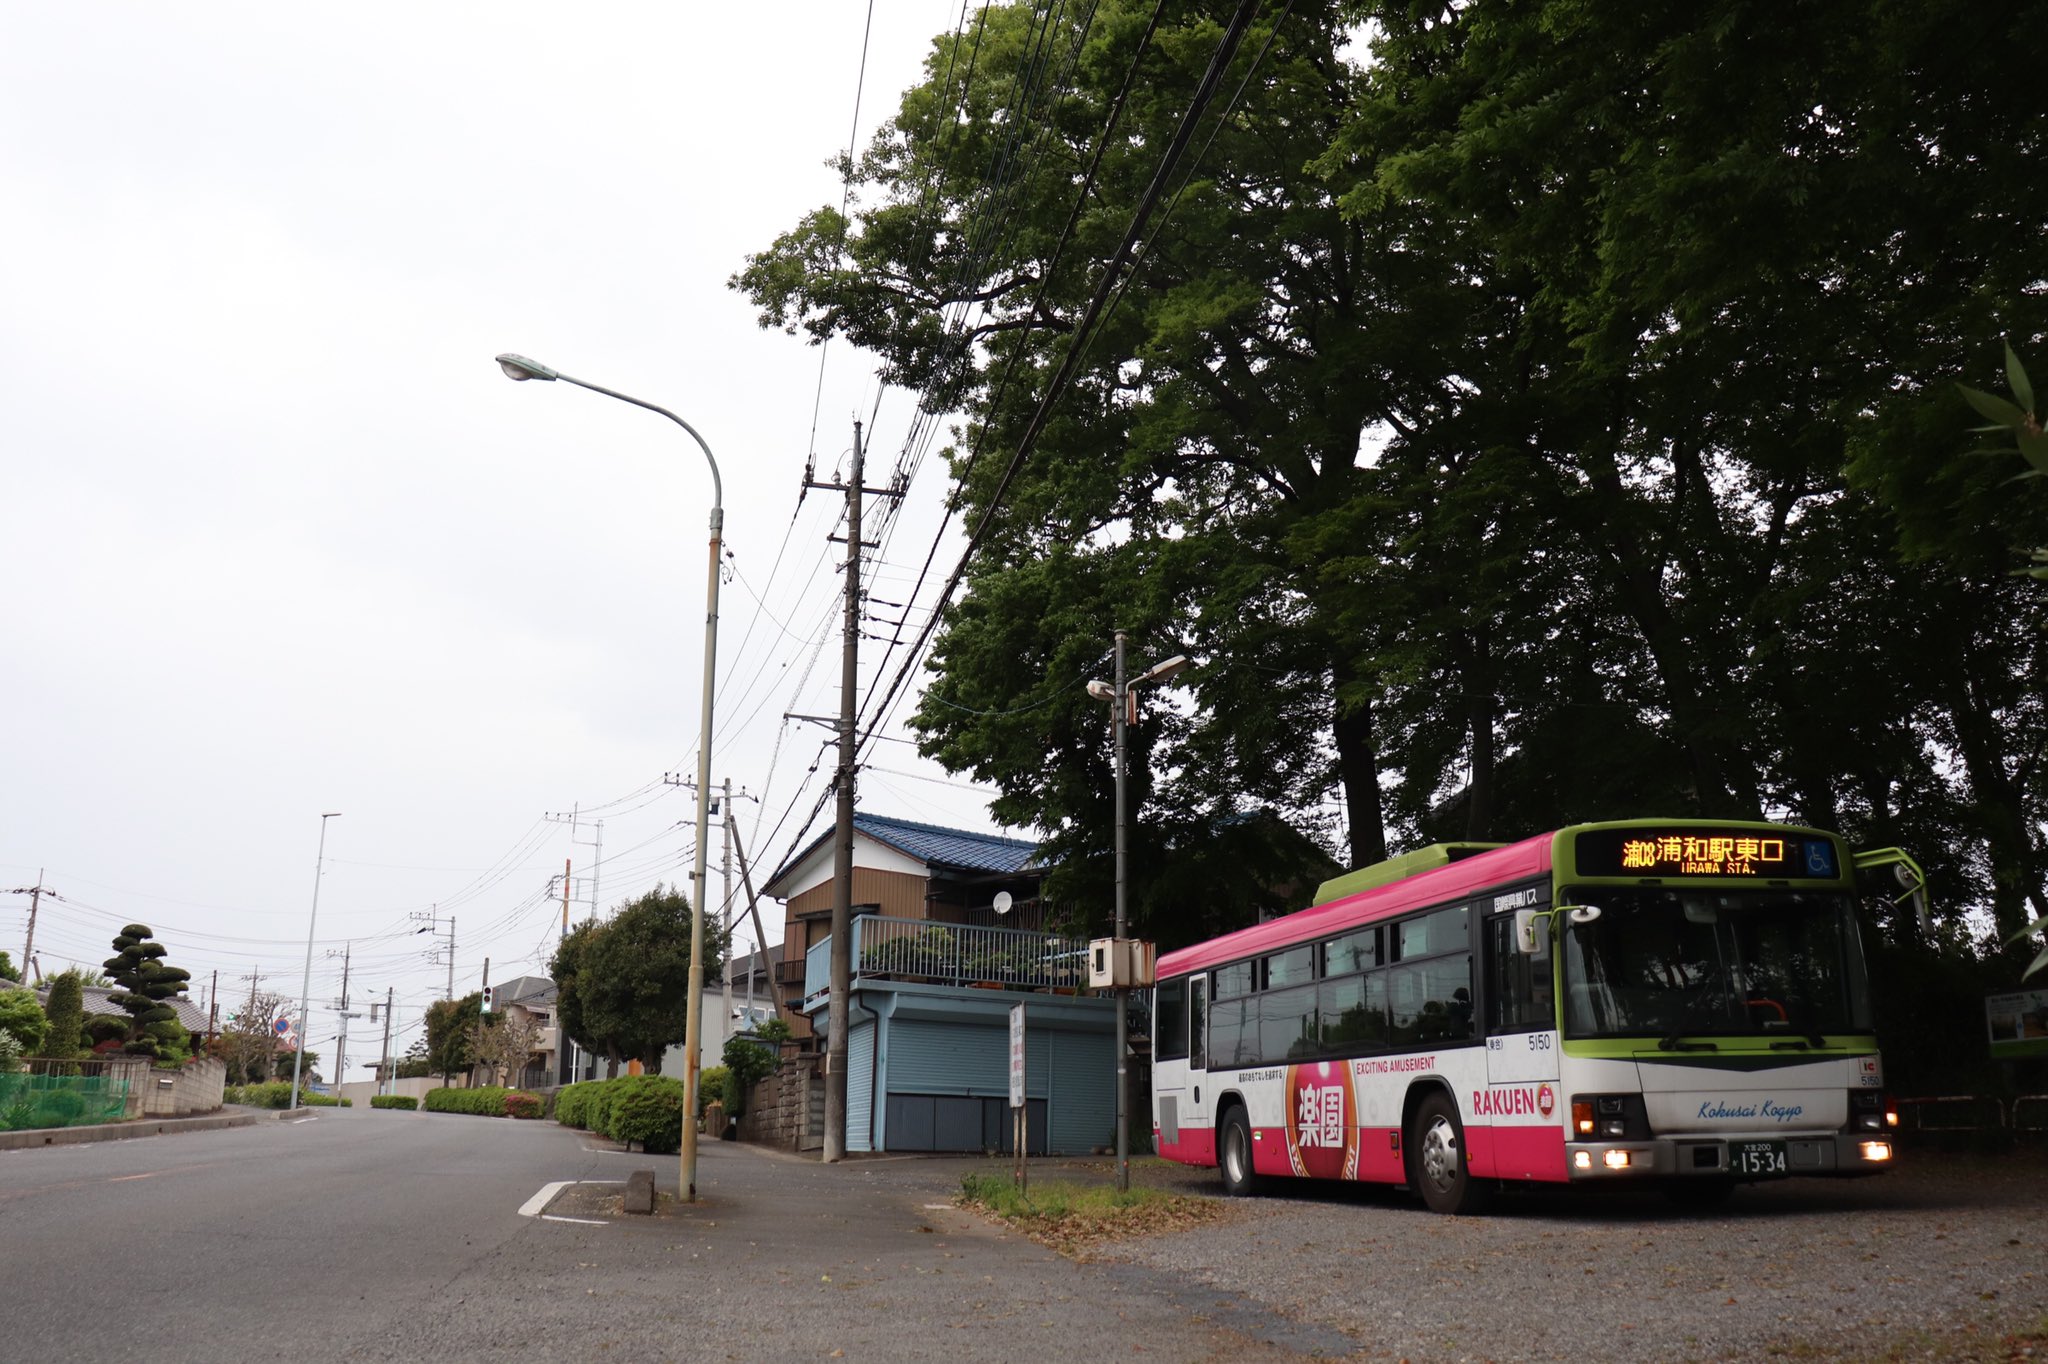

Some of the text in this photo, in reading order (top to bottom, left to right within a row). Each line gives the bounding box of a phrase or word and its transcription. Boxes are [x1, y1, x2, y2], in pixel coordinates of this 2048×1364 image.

[1656, 836, 1783, 863] 浦和駅東口
[1528, 1034, 1551, 1051] 5150
[1357, 1056, 1435, 1075] EXCITING AMUSEMENT
[1473, 1088, 1535, 1115] RAKUEN
[1698, 1100, 1803, 1122] Kokusai Kogyo
[1299, 1083, 1344, 1148] 楽園
